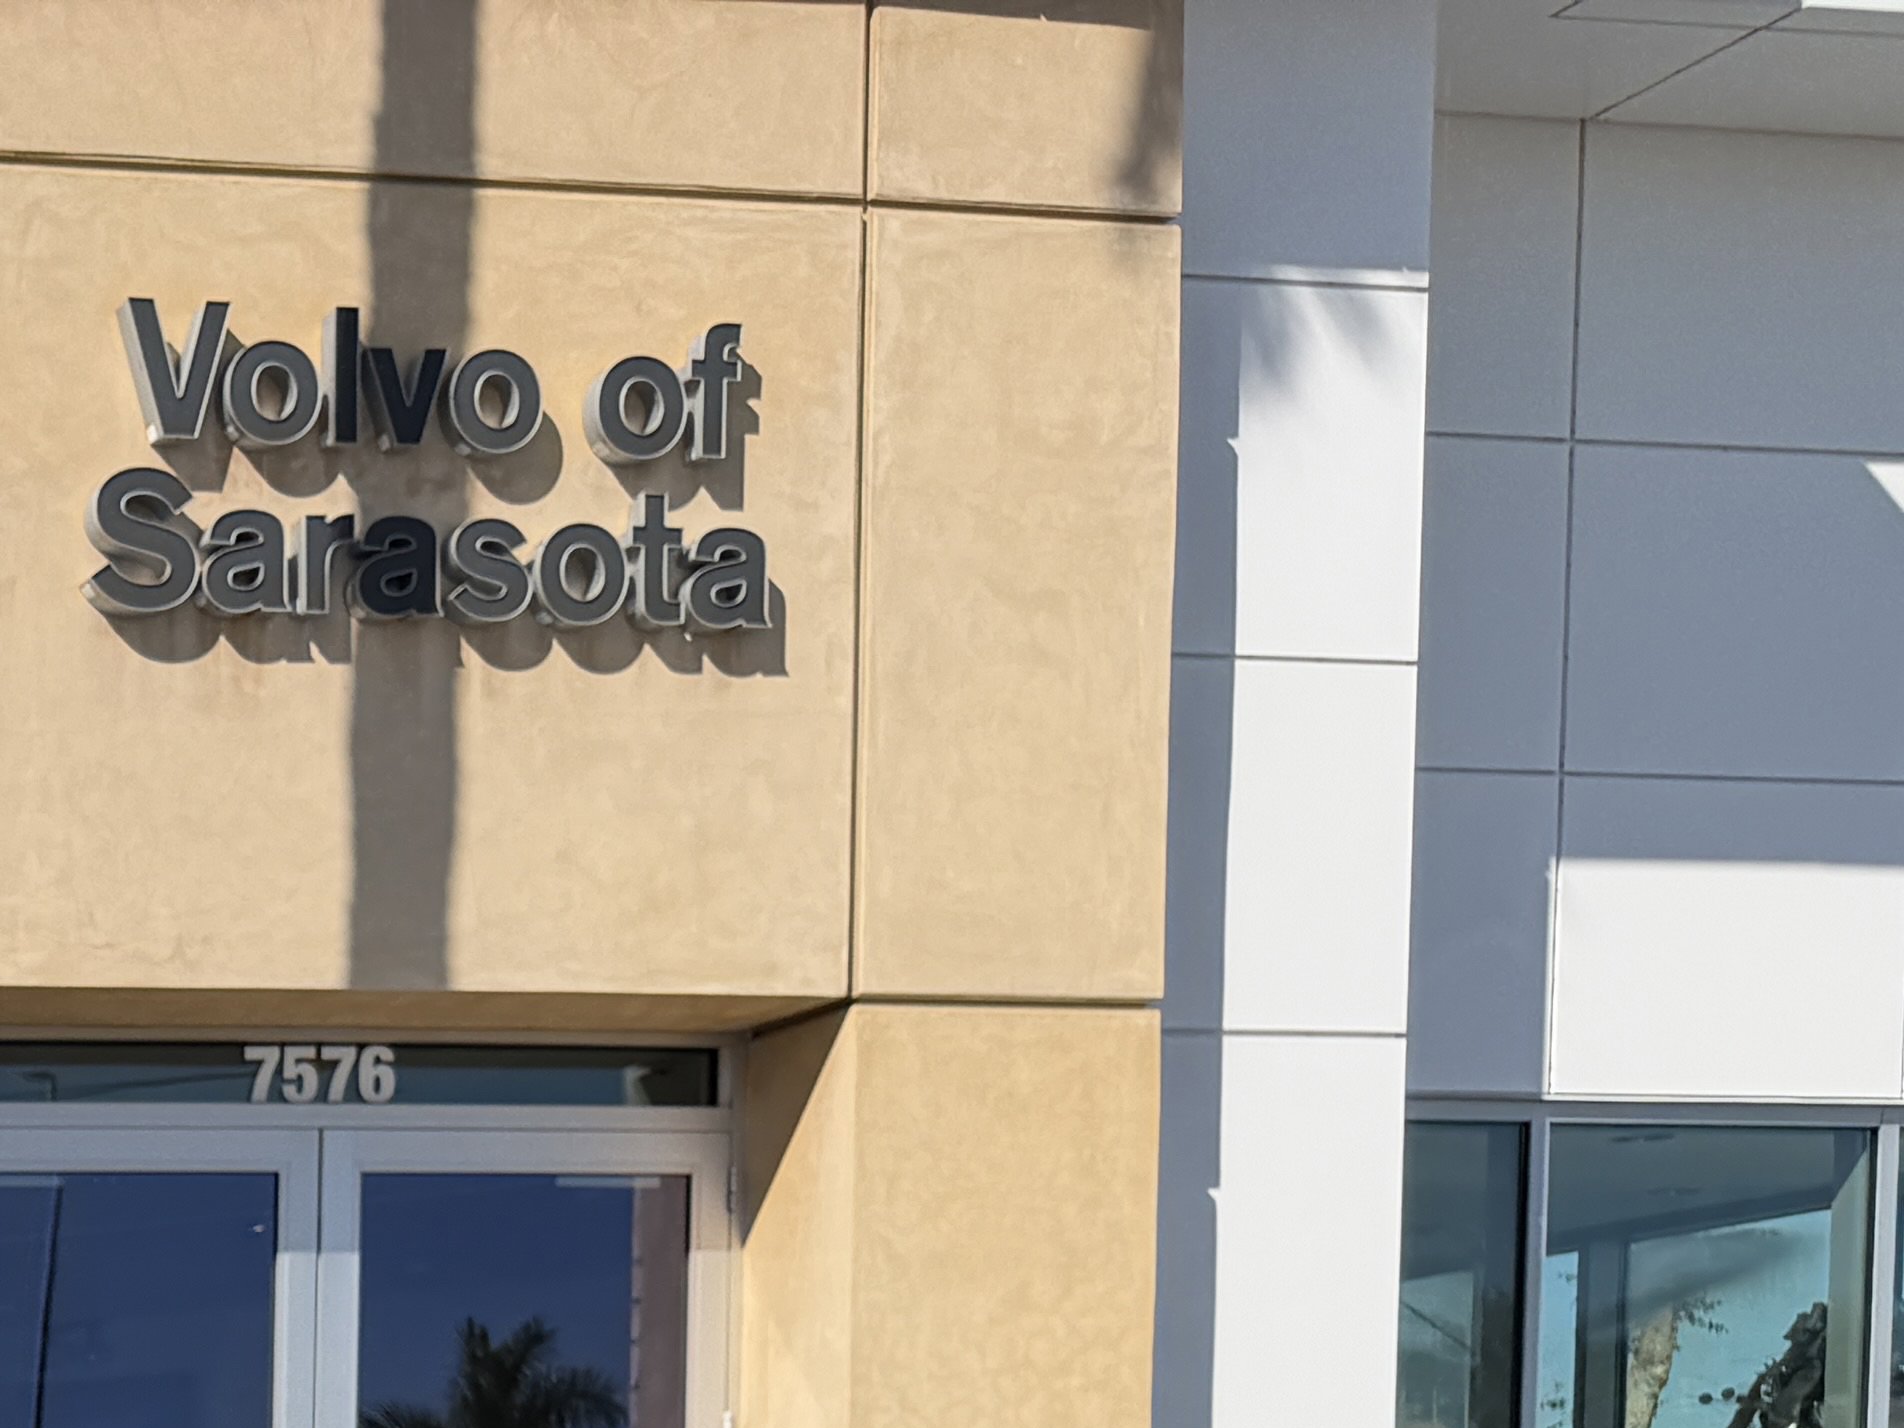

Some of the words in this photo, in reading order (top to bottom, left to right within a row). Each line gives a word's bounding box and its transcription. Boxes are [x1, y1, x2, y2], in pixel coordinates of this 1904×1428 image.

[117, 297, 542, 456] Volvo
[586, 322, 743, 465] of
[81, 467, 771, 634] Sarasota
[244, 1045, 396, 1103] 7576
